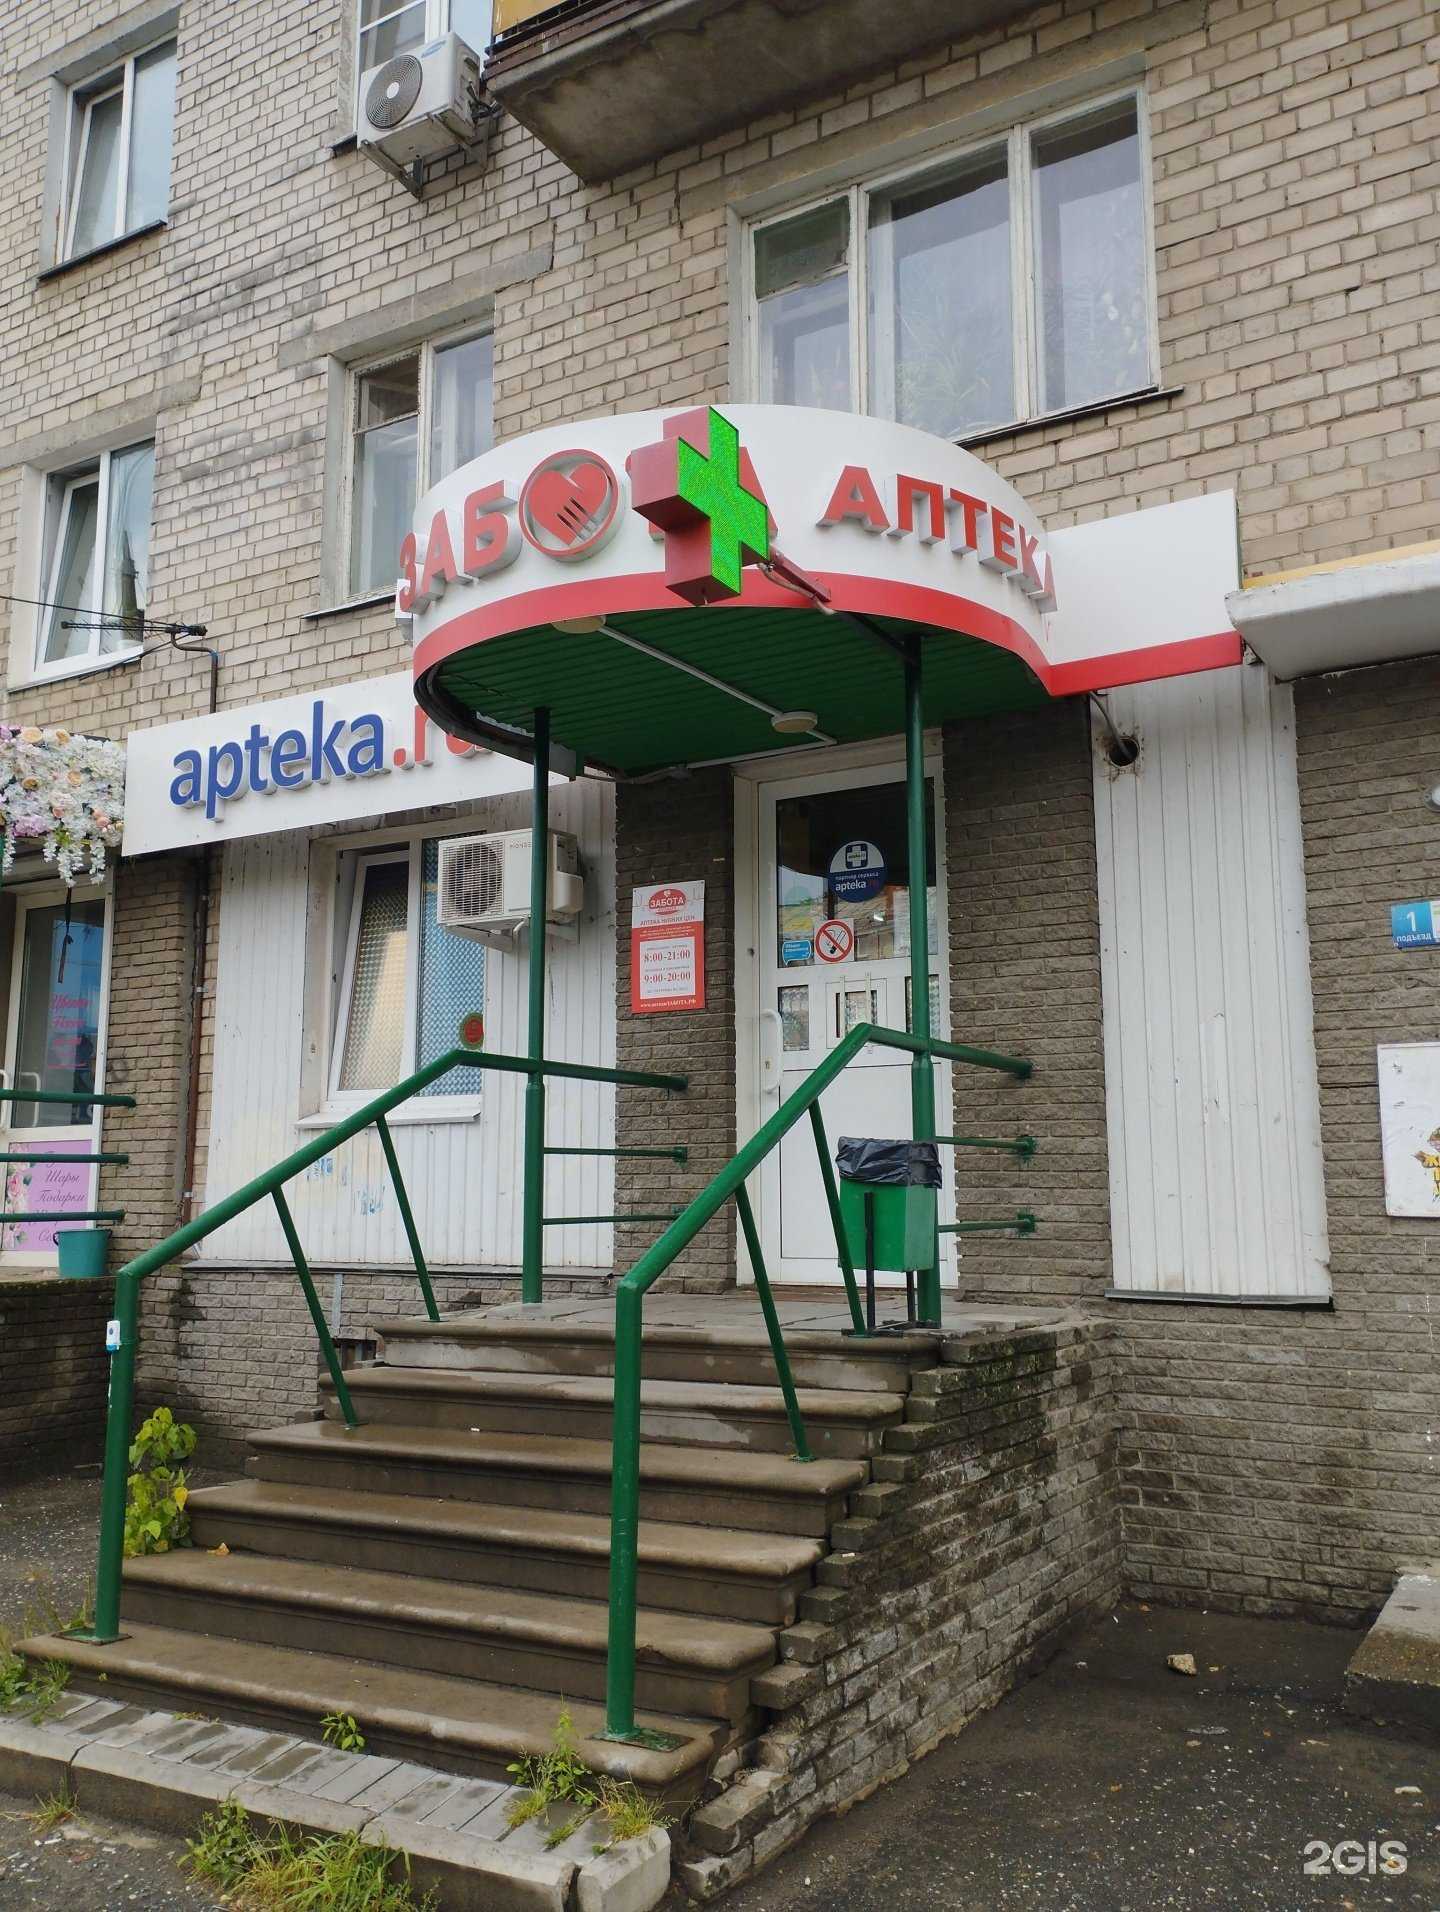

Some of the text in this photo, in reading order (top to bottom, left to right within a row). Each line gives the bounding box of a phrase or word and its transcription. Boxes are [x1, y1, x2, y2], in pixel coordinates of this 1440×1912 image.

[398, 448, 778, 613] ЗАБО
[169, 700, 485, 819] apteka.r
[650, 896, 685, 908] ЗАБОТА
[1406, 911, 1417, 932] 1
[644, 971, 691, 983] 9:00-20:00
[45, 1169, 81, 1187] Шары
